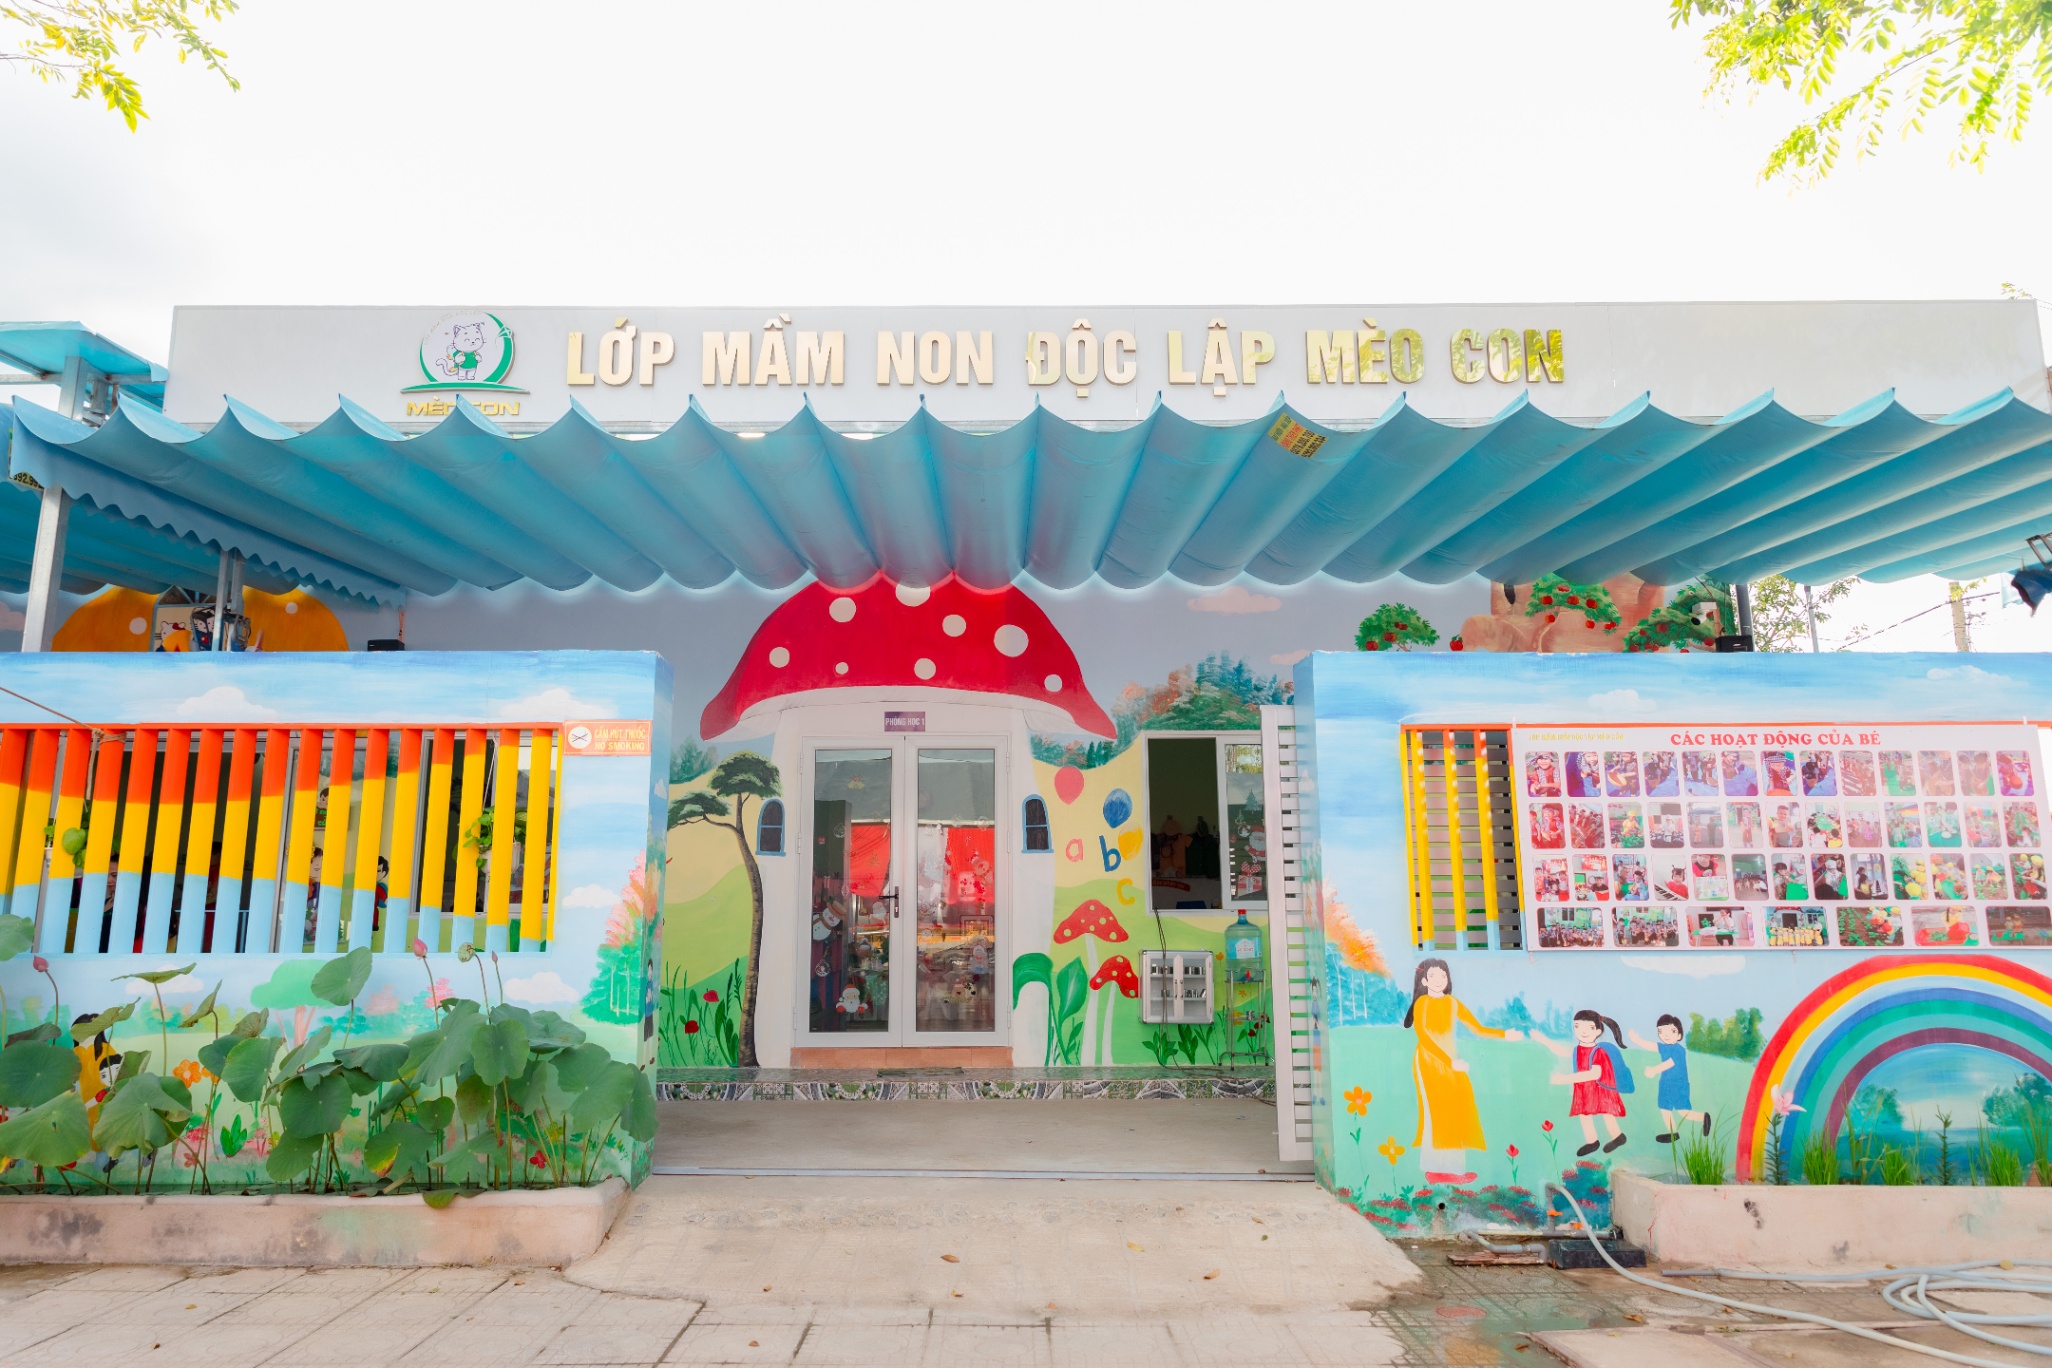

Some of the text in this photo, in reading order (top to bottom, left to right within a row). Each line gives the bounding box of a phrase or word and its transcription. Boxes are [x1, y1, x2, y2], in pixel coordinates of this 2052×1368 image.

[567, 312, 1566, 398] LỚP MẦM NON ĐỘC LẬP MÈO CON
[885, 715, 925, 728] PHÒNG HỌC 1
[610, 726, 623, 739] HÚT
[1670, 728, 1881, 748] CÁC HOẠT ĐỘNG CỦA BÉ
[594, 741, 645, 751] NO SMOKING
[1065, 838, 1084, 862] a
[1099, 835, 1121, 872] b
[1116, 877, 1135, 906] c
